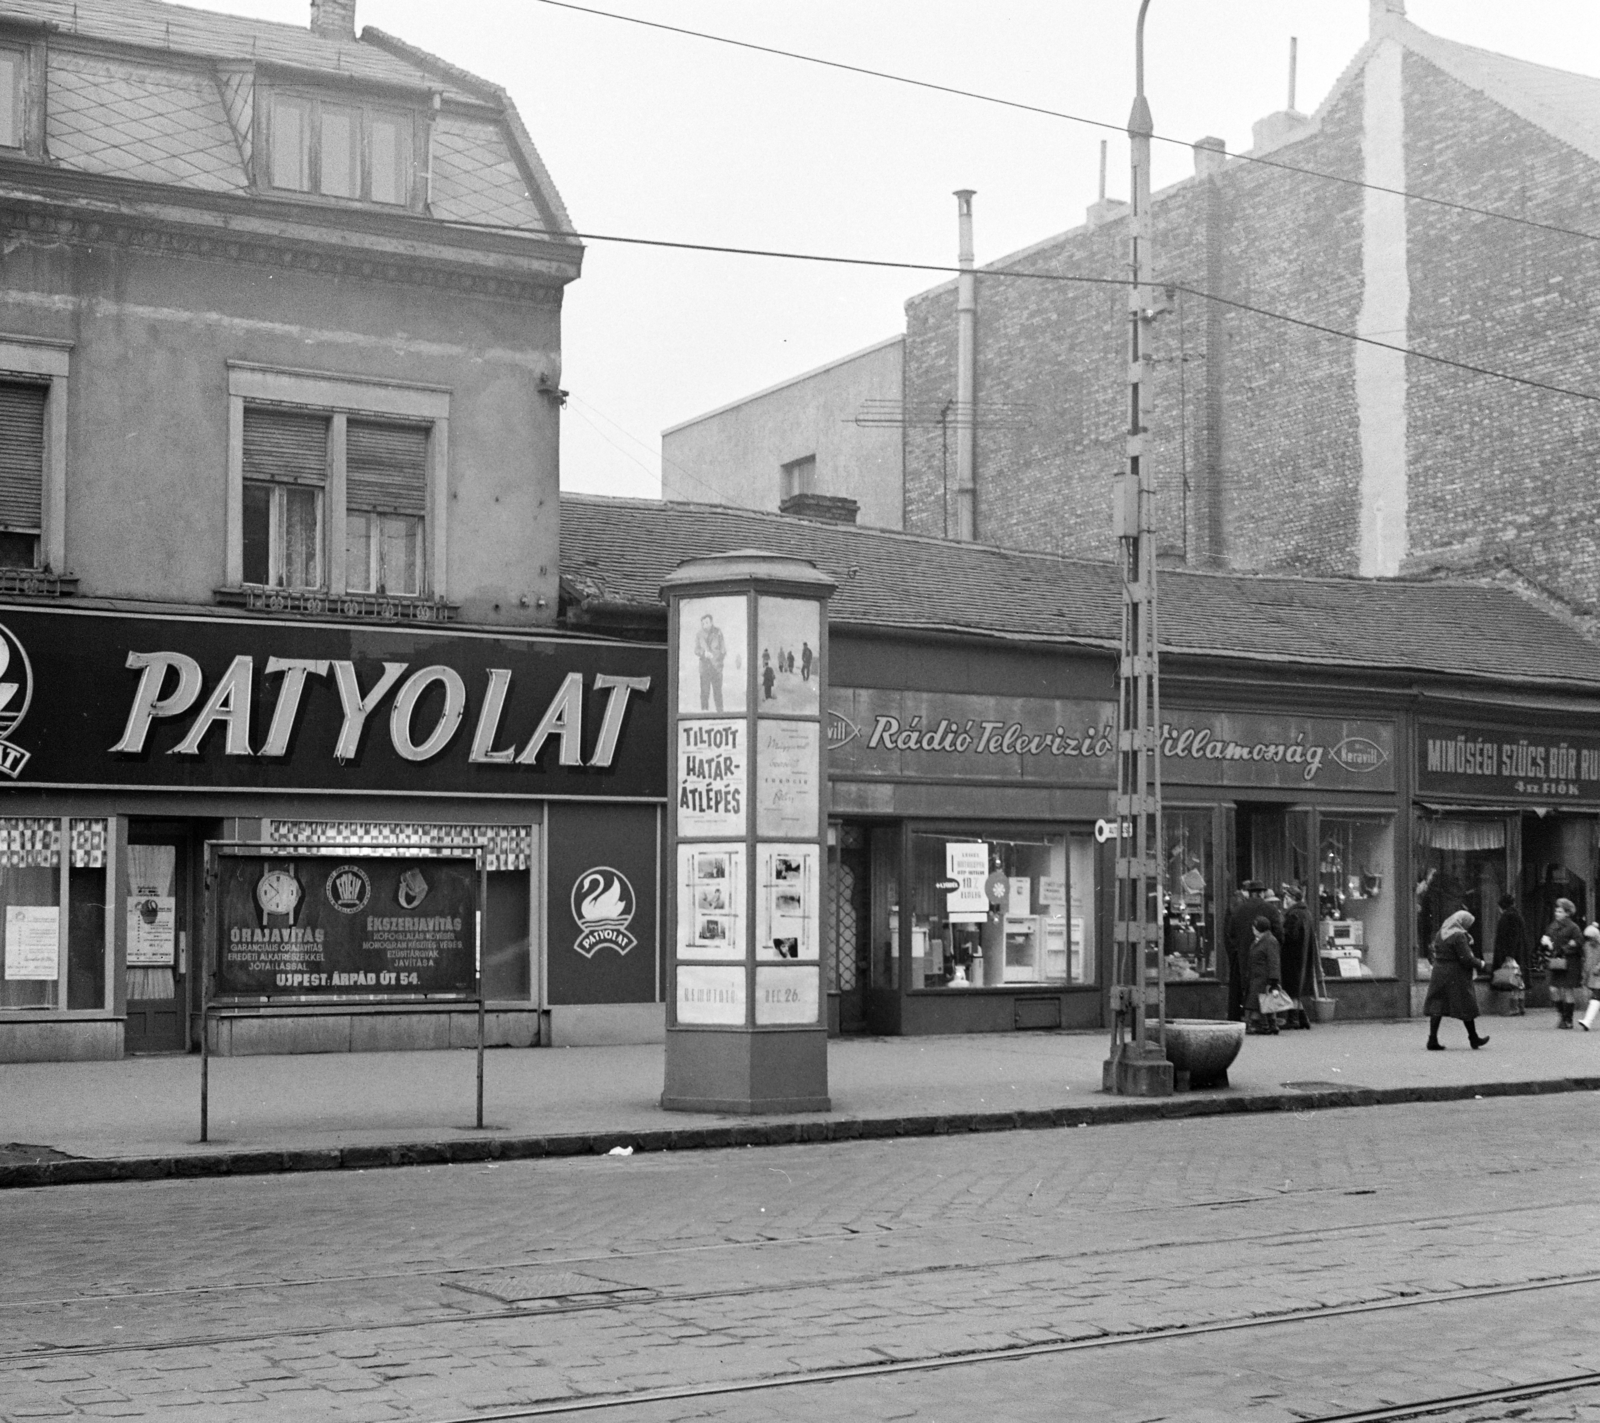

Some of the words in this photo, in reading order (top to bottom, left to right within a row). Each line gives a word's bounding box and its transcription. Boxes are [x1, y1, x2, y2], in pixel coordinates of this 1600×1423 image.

[107, 650, 651, 767] PATYOLAT
[683, 726, 739, 749] TILTOTT
[868, 715, 974, 752] Rádió
[1147, 724, 1324, 781] illamosság
[686, 753, 741, 781] HATÁR-
[1427, 735, 1498, 776] MINŐSÉGI
[1549, 742, 1577, 780] BŐR
[680, 779, 741, 815] ÁTLÉPÉS
[1542, 780, 1579, 796] FIÓK
[366, 915, 462, 931] ÉKSZERJAVÍTÁS
[230, 926, 325, 943] ÓRAJAVÍTÁS
[582, 929, 629, 949] PATYOLAT
[230, 943, 279, 952] GARANCIÁLIS
[279, 943, 323, 952] ÓRAJAVÍTÁS
[259, 952, 325, 962] ALKATRÉSZEKKEL
[331, 970, 376, 986] ÁRPÁD
[380, 970, 397, 985] ÚT
[400, 972, 421, 985] 54.
[684, 982, 736, 1004] BEMUTATÓ
